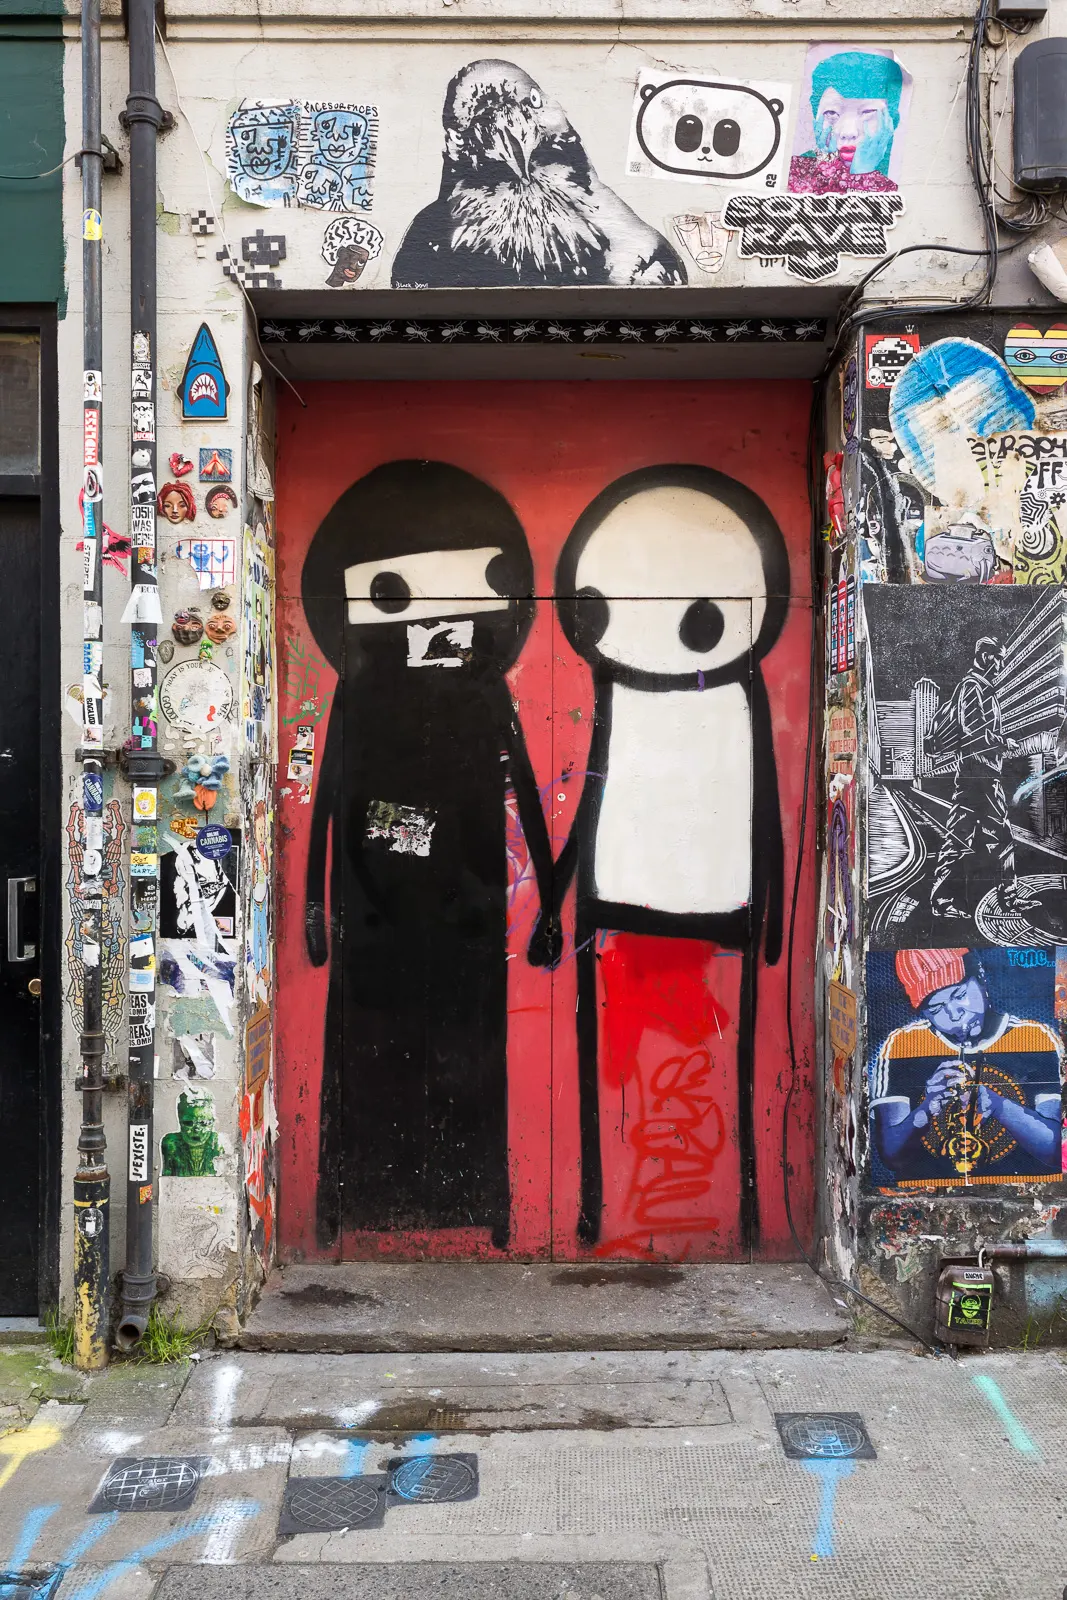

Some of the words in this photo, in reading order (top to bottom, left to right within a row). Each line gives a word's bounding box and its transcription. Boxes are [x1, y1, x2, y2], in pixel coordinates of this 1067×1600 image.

[743, 221, 884, 246] RAVE
[84, 410, 97, 463] ENDLESS
[133, 520, 152, 532] WAS
[283, 636, 305, 699] LOVE
[200, 834, 228, 846] CANNABIS
[132, 1127, 146, 1179] J'EXISTE.
